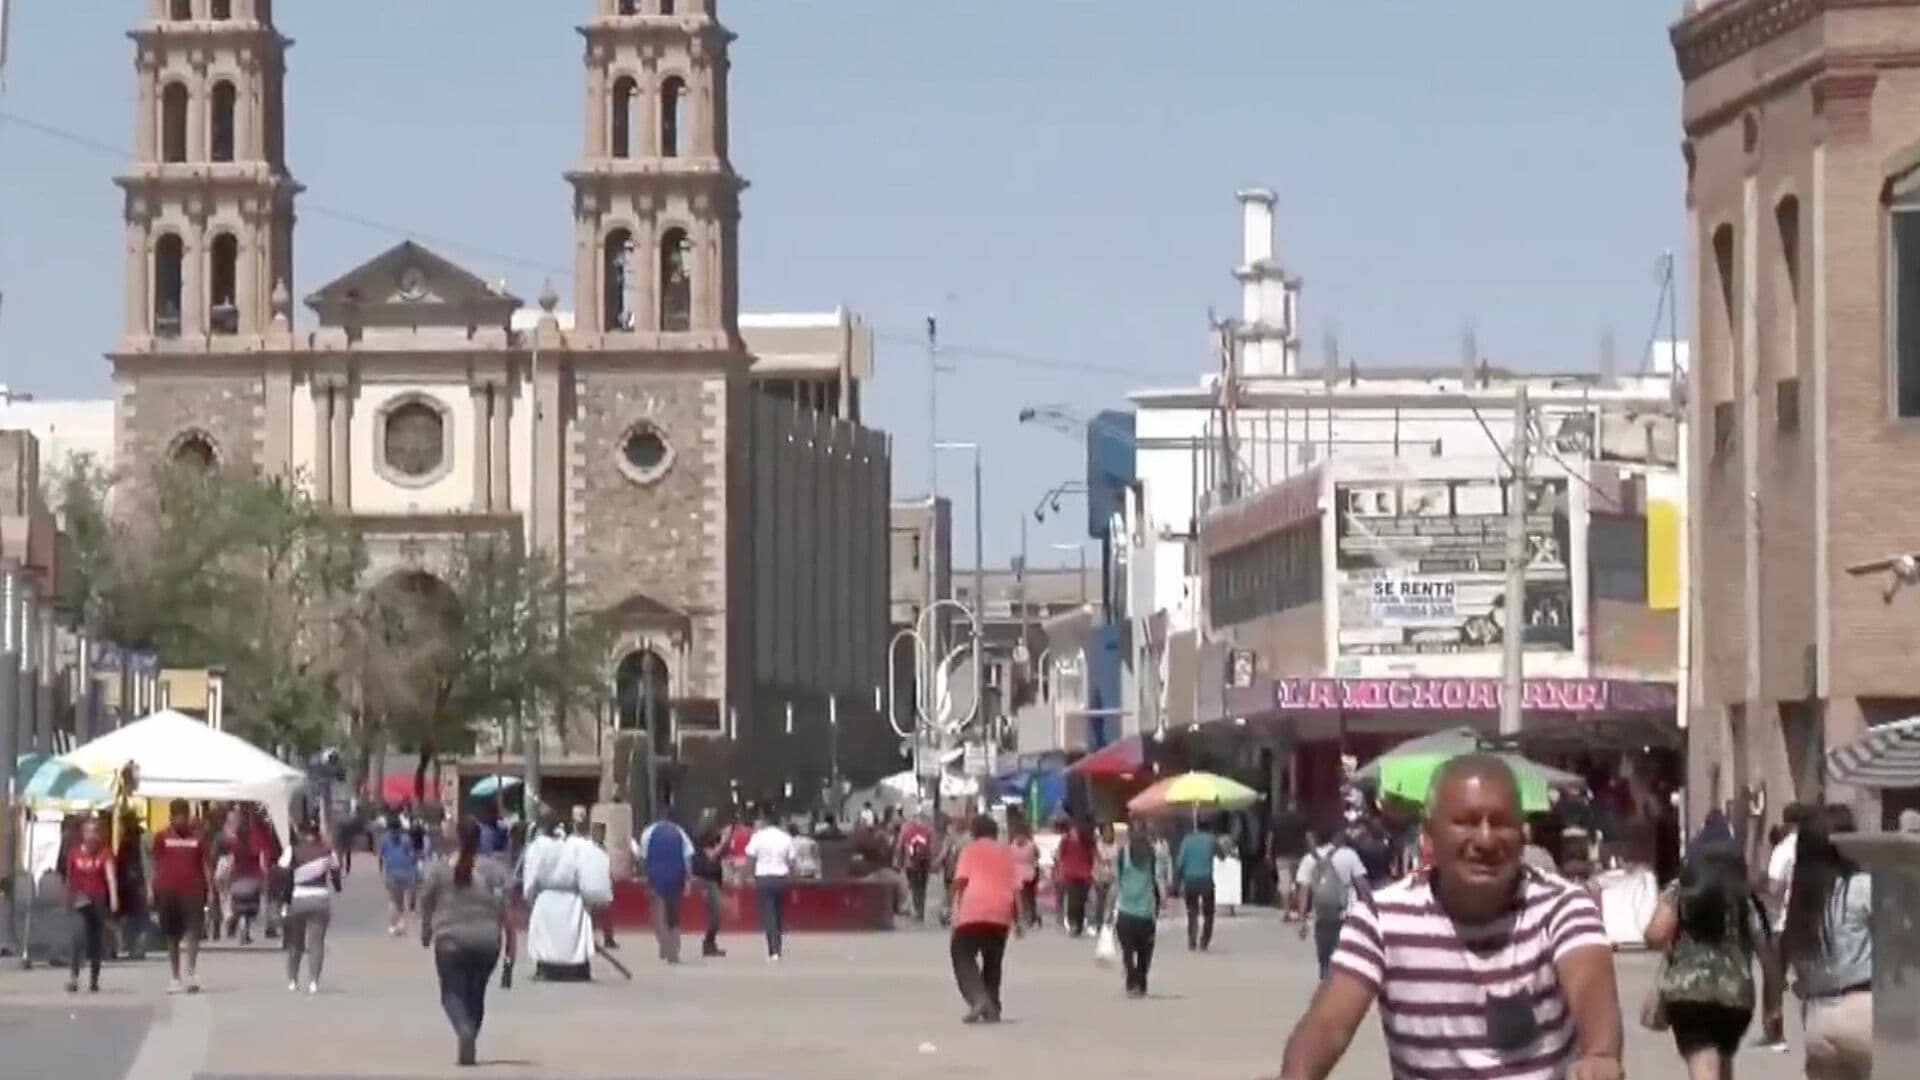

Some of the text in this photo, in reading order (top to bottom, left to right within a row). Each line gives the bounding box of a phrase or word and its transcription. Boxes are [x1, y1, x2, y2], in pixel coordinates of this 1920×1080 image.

[1374, 581, 1455, 596] SE RENTA
[1278, 679, 1609, 709] LA MICHOAANA
